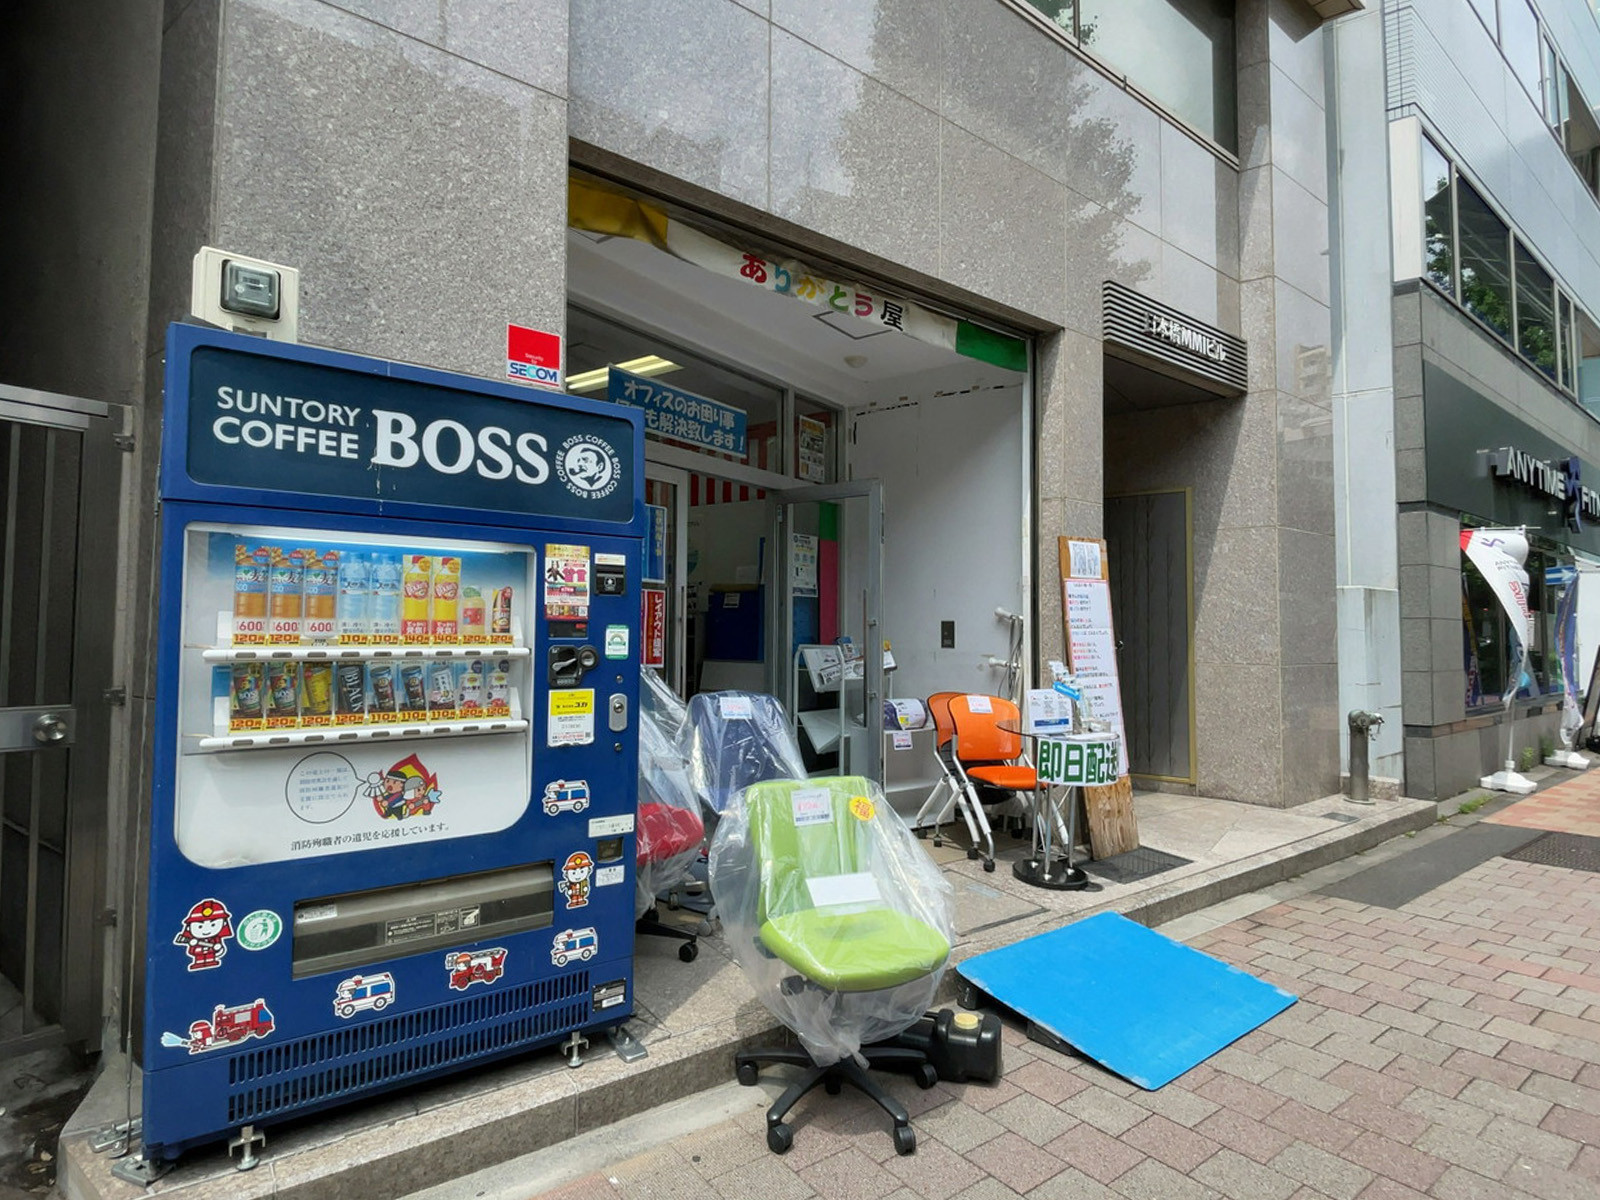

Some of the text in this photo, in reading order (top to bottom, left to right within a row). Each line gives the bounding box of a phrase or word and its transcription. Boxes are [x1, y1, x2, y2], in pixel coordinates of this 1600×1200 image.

[740, 254, 903, 331] ありがとう屋
[510, 362, 558, 383] SECOM
[217, 386, 361, 427] SUNTORY
[616, 399, 744, 451] も解決致します!
[624, 381, 735, 429] オフィスのお困り事
[212, 409, 550, 485] COFFEE BOSS
[555, 435, 621, 499] BOSS COFFEE BOSS COFFEE BOSS COFFEE
[1507, 446, 1566, 500] ANYTIME
[239, 621, 263, 632] 600
[275, 622, 298, 632] 600
[310, 622, 332, 632] 600
[344, 667, 363, 712] BLACK
[1039, 740, 1117, 783] 即日配送
[291, 822, 450, 851] 消防殉職者の遺児を応援しています。
